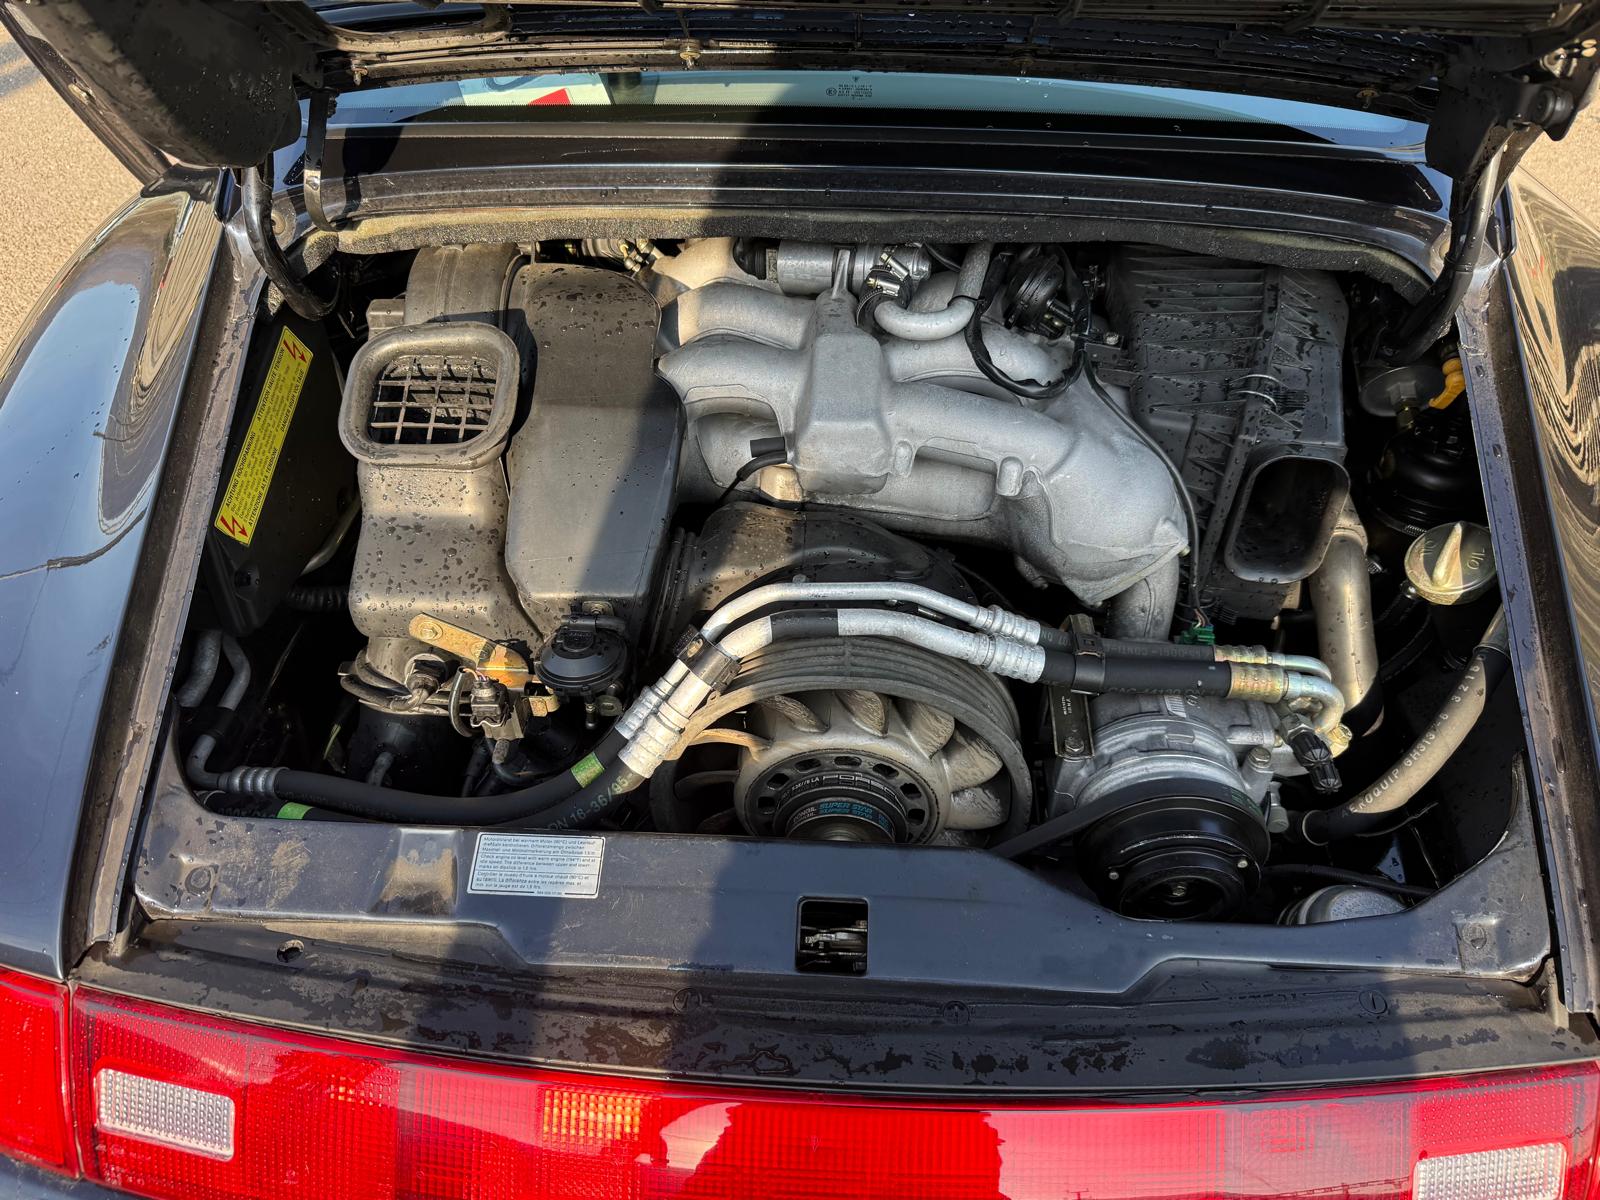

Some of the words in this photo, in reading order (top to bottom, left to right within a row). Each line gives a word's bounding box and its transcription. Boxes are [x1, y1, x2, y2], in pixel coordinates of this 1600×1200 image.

[257, 390, 270, 422] ATTENTION
[273, 348, 285, 371] TENSION
[226, 478, 239, 508] ACHTUNG
[248, 492, 263, 527] ATTENZIONE
[260, 475, 269, 491] ALTA
[1467, 548, 1486, 570] OIL
[818, 802, 850, 810] SUPER
[851, 804, 873, 814] STAR
